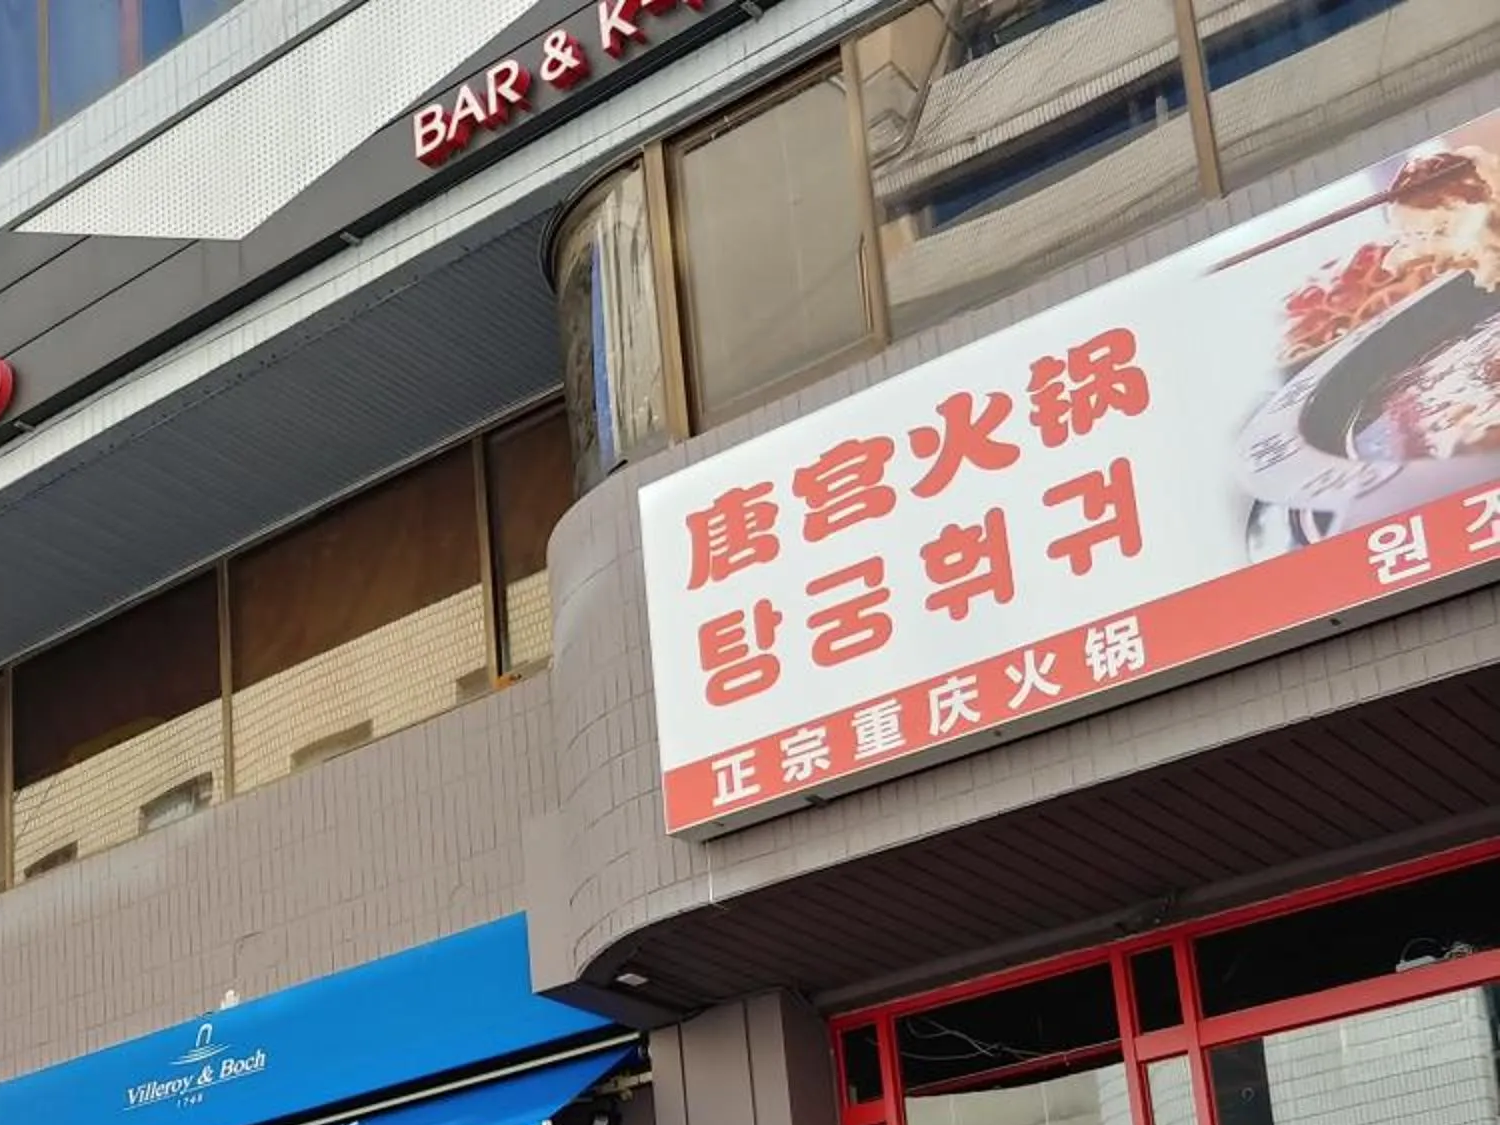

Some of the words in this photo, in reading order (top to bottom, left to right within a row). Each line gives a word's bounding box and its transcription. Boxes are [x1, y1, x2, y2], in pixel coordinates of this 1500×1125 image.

[412, 59, 524, 161] BAR
[540, 29, 583, 84] &
[685, 327, 1151, 591] 唐宫火锅
[710, 616, 1147, 808] 正宗重庆火锅
[127, 1074, 194, 1106] Villeroy
[197, 1065, 214, 1085] &
[219, 1048, 266, 1080] Boch
